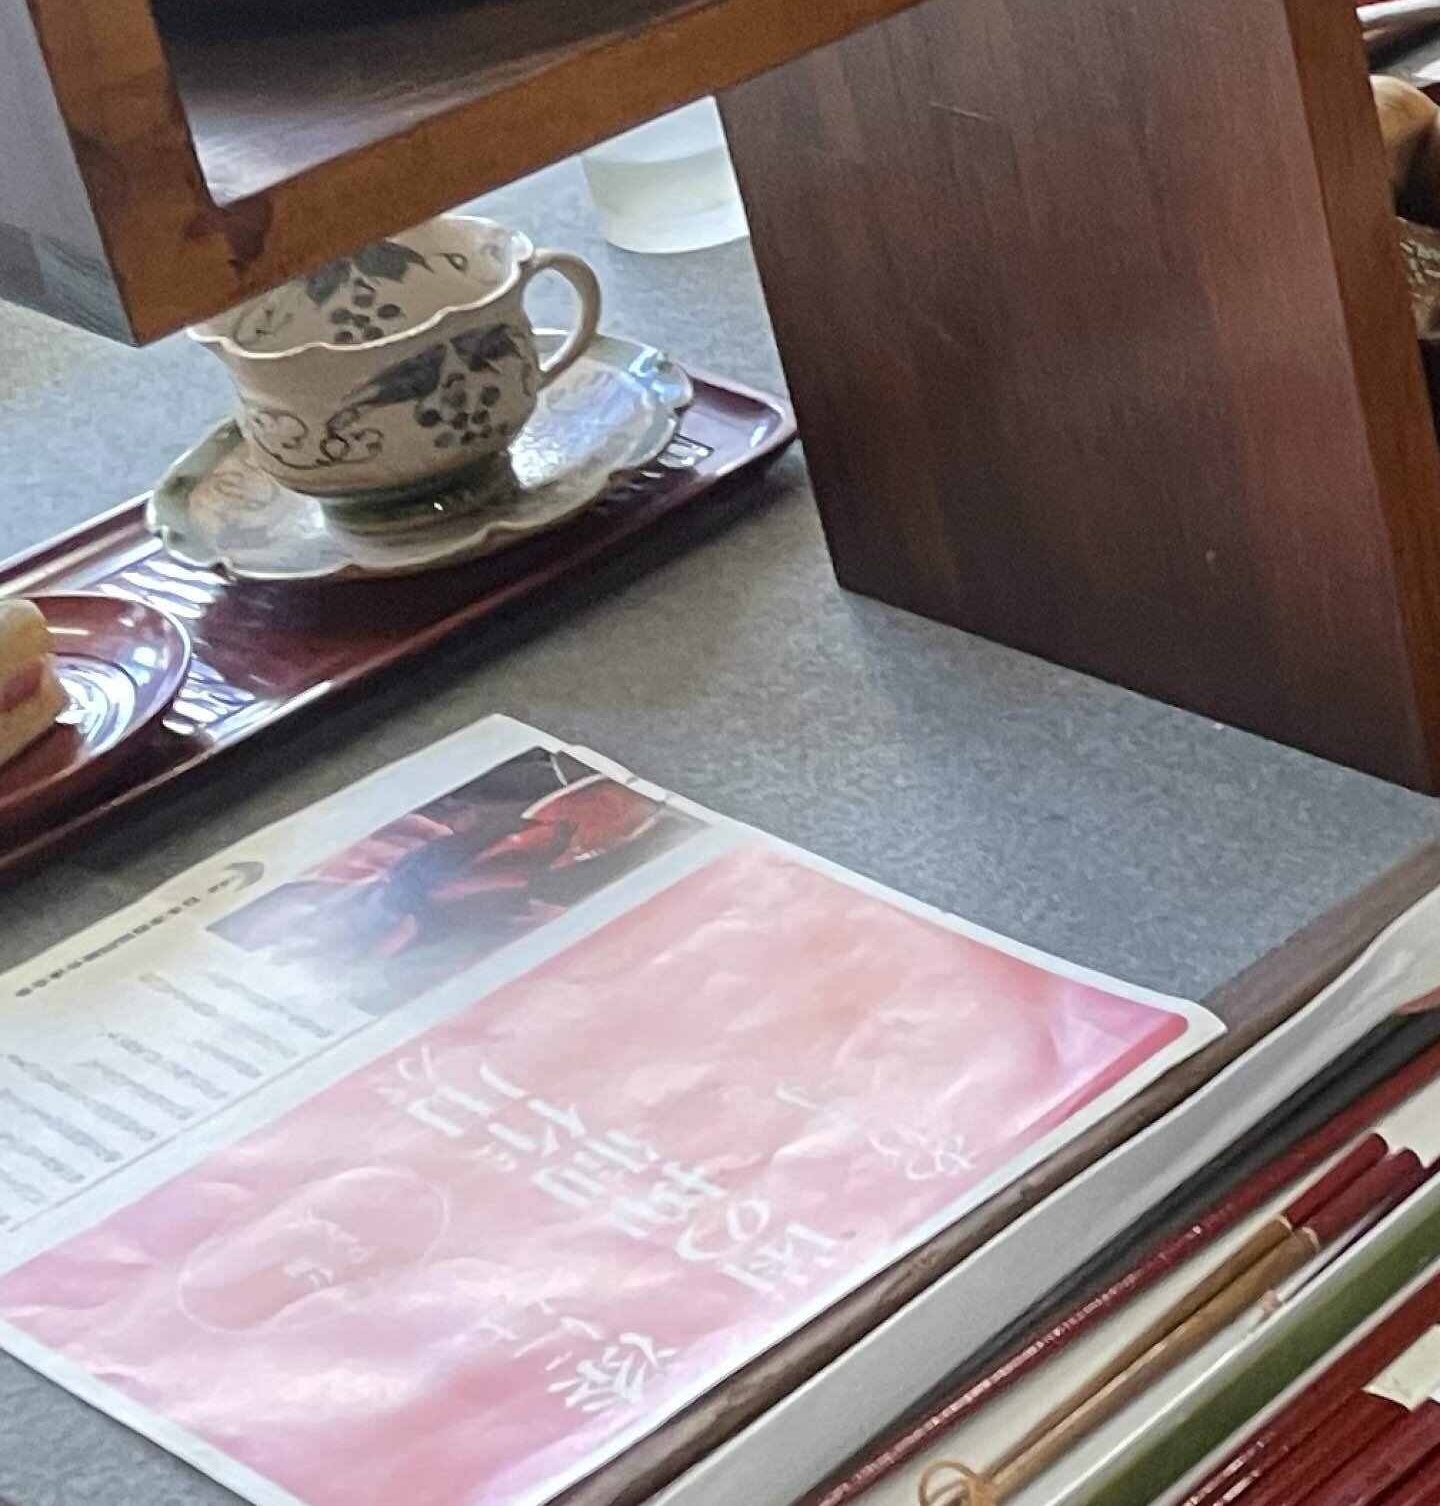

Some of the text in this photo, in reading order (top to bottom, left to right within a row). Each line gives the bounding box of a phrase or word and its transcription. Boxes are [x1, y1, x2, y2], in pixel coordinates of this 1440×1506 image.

[380, 1046, 841, 1293] 菌の抑制作用が
[774, 1080, 979, 1181] ありす
